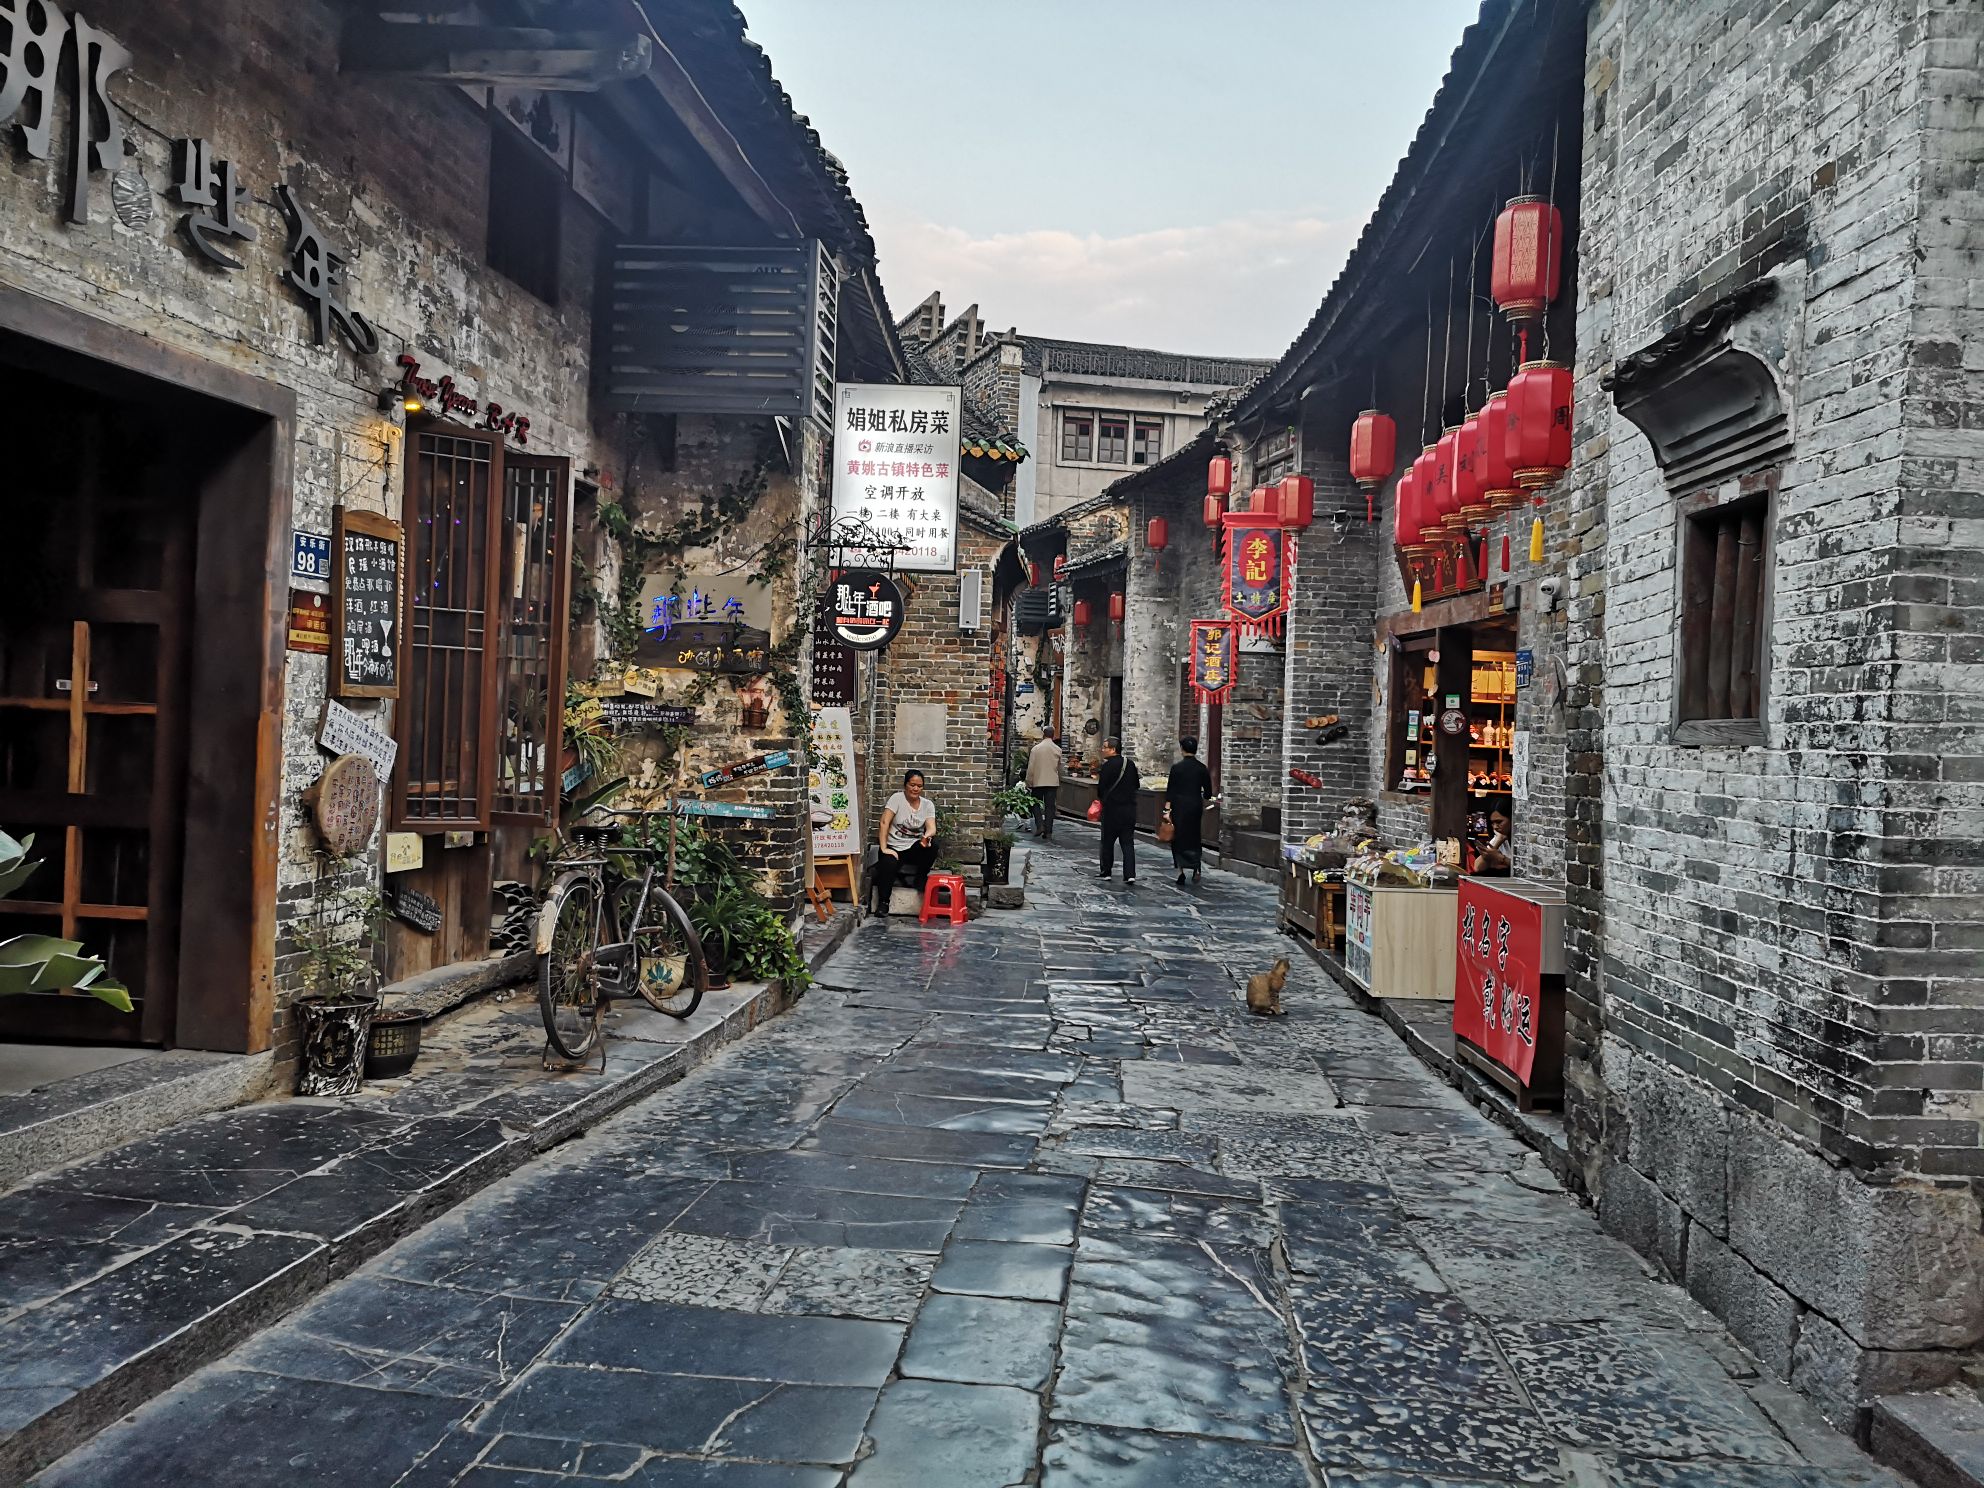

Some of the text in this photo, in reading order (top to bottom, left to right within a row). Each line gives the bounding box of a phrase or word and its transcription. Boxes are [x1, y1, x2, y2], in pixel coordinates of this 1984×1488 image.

[846, 407, 950, 435] 娟姐私房菜
[874, 441, 935, 455] 新浪直播采访
[846, 460, 950, 479] 黄姚古镇特色菜
[864, 484, 926, 502] 空调开放
[846, 506, 942, 521] 一楼 二楼 有大桌
[905, 526, 950, 539] 同时用餐
[299, 536, 326, 551] 安乐街
[297, 551, 316, 572] 98
[1246, 538, 1268, 581] 李記
[835, 584, 867, 618] 那些年
[866, 600, 892, 617] 酒吧
[346, 620, 373, 634] 鸡尾酒
[361, 638, 379, 655] 啤酒
